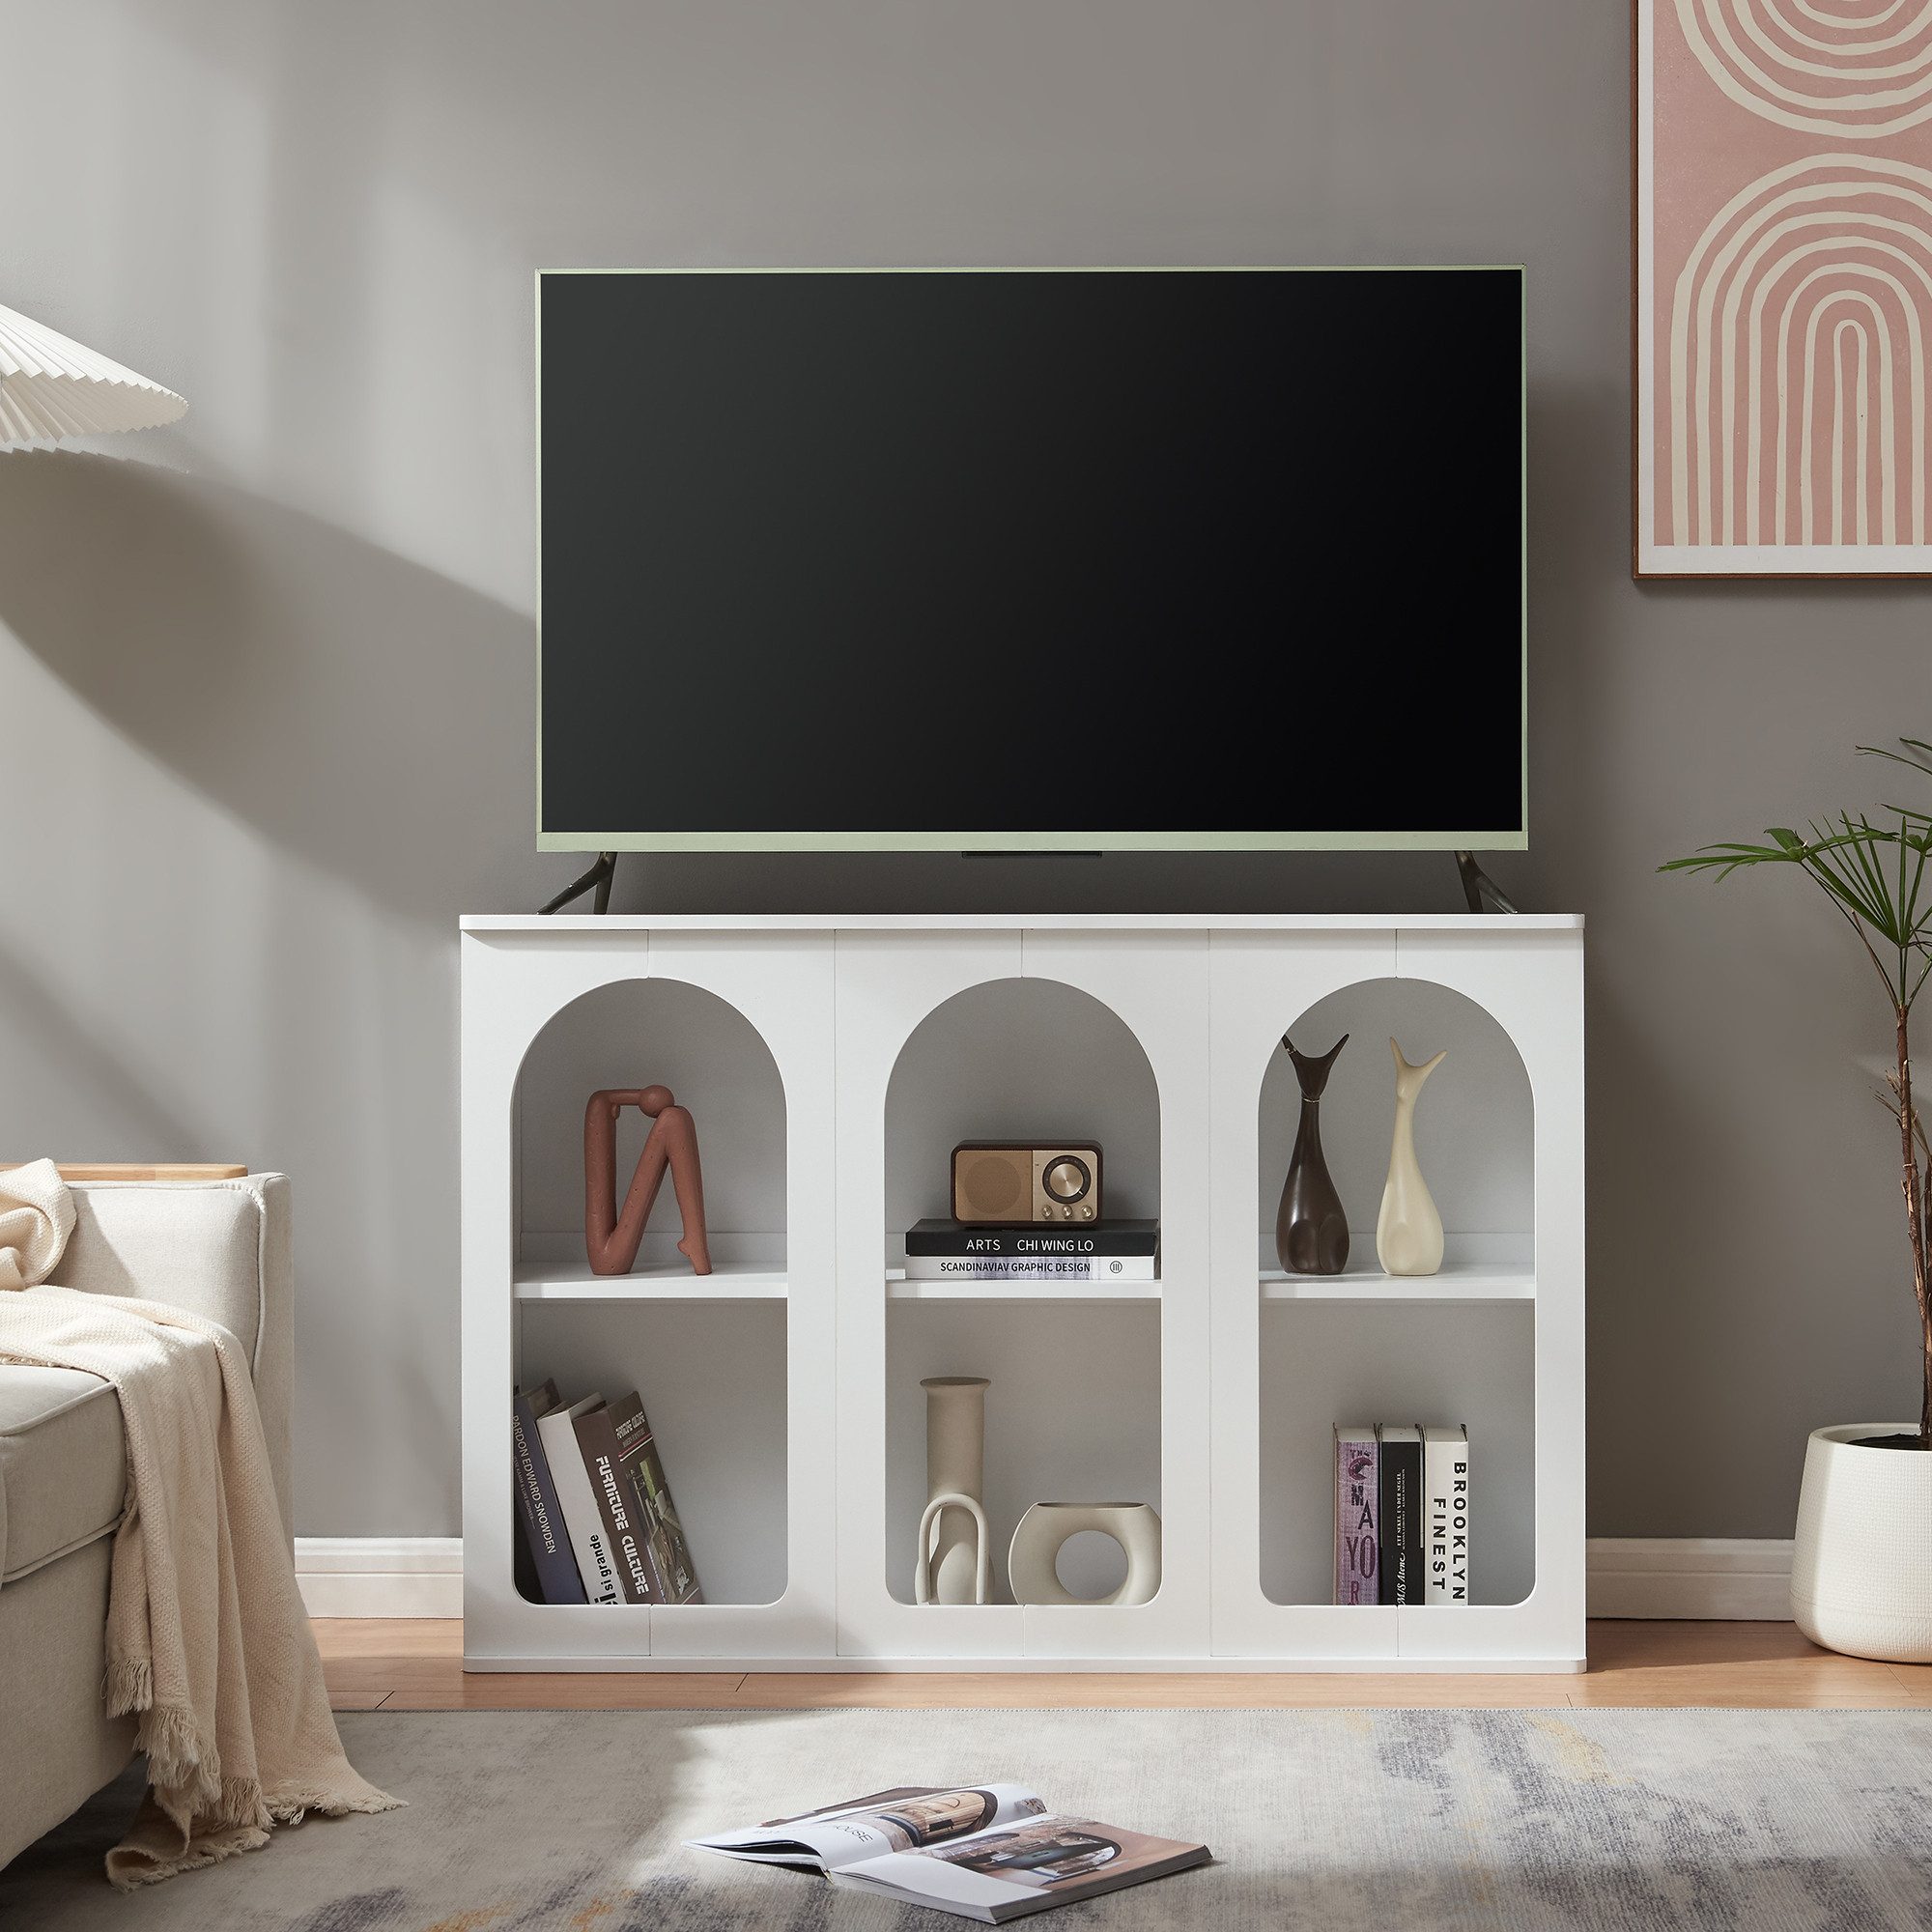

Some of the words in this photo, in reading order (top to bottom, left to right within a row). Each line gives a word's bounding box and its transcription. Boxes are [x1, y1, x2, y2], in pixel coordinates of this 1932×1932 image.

[966, 1239, 1001, 1251] ARTS
[1016, 1239, 1038, 1251] CHI
[1040, 1239, 1074, 1252] WING
[1077, 1240, 1094, 1252] LO
[1010, 1262, 1053, 1272] GRAPHIC
[1055, 1263, 1091, 1272] DESIGN
[522, 1458, 541, 1501] EDWARD
[534, 1502, 556, 1553] SNOWDEN
[1453, 1462, 1466, 1599] BROOKLYN
[589, 1534, 611, 1577] grande
[621, 1535, 649, 1595] CULTURE
[1433, 1498, 1446, 1589] FINEST
